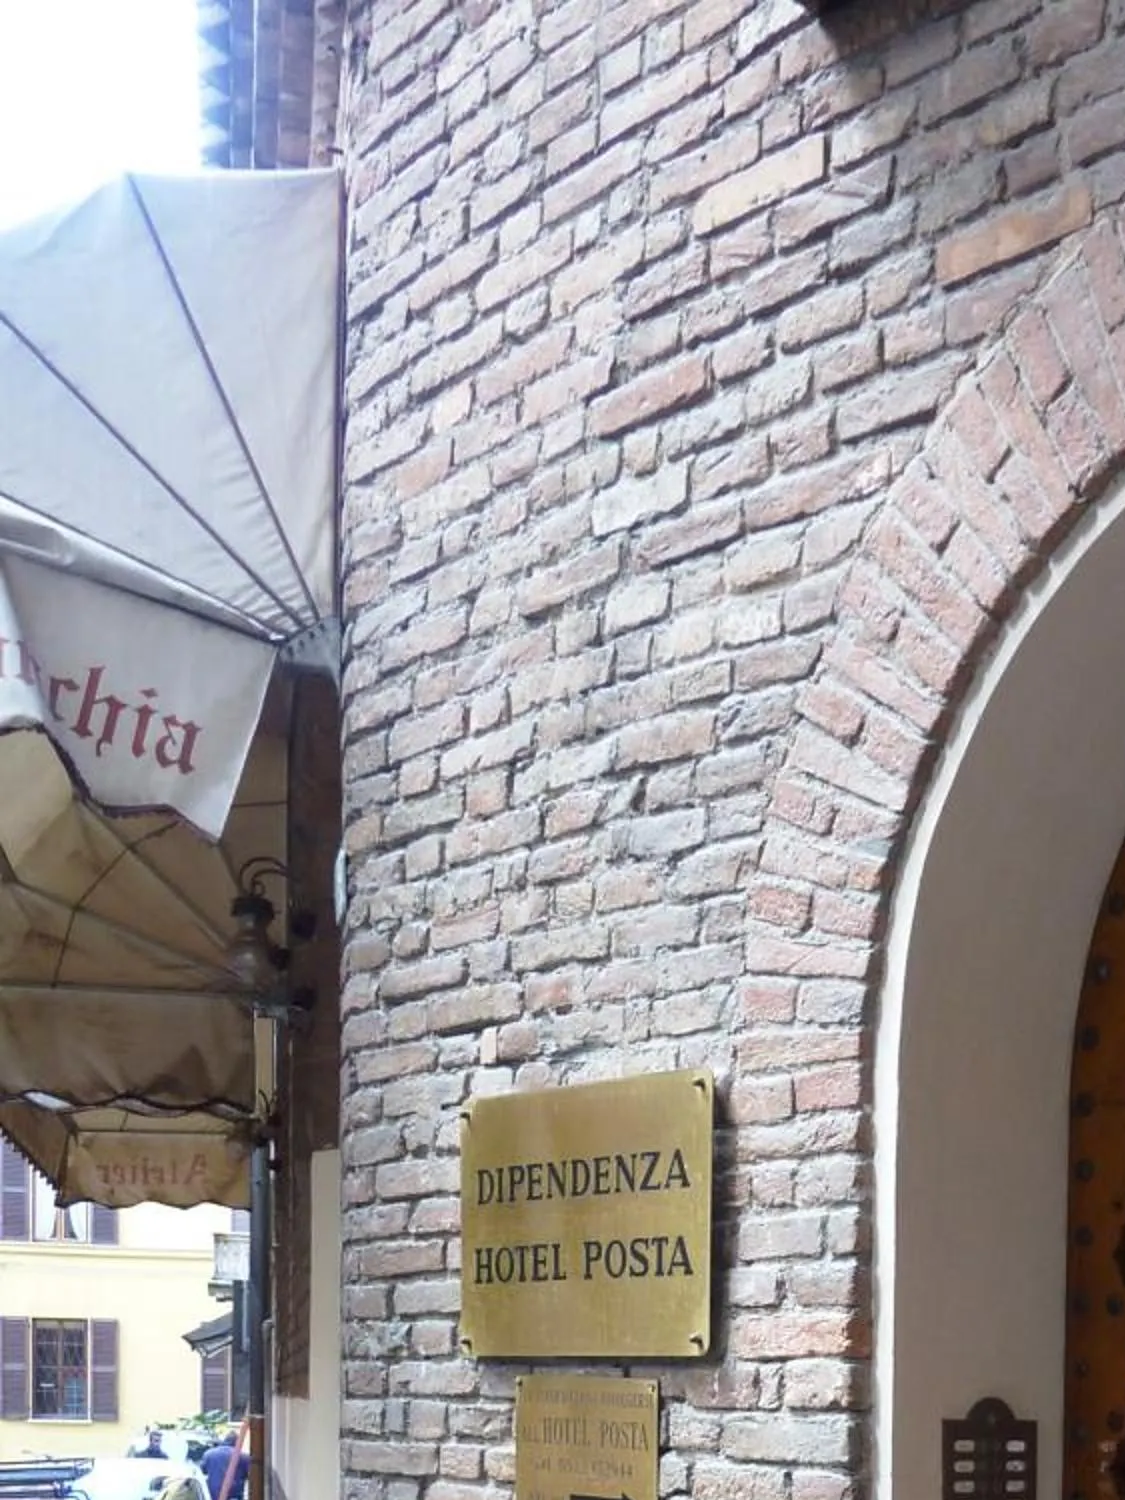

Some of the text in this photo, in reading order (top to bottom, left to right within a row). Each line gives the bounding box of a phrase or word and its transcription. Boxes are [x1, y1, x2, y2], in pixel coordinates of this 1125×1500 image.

[477, 1148, 690, 1206] DIPENDENZA
[475, 1236, 693, 1285] HOTEL POSTA
[542, 1415, 591, 1447] HOTEL
[599, 1421, 650, 1452] POSTA
